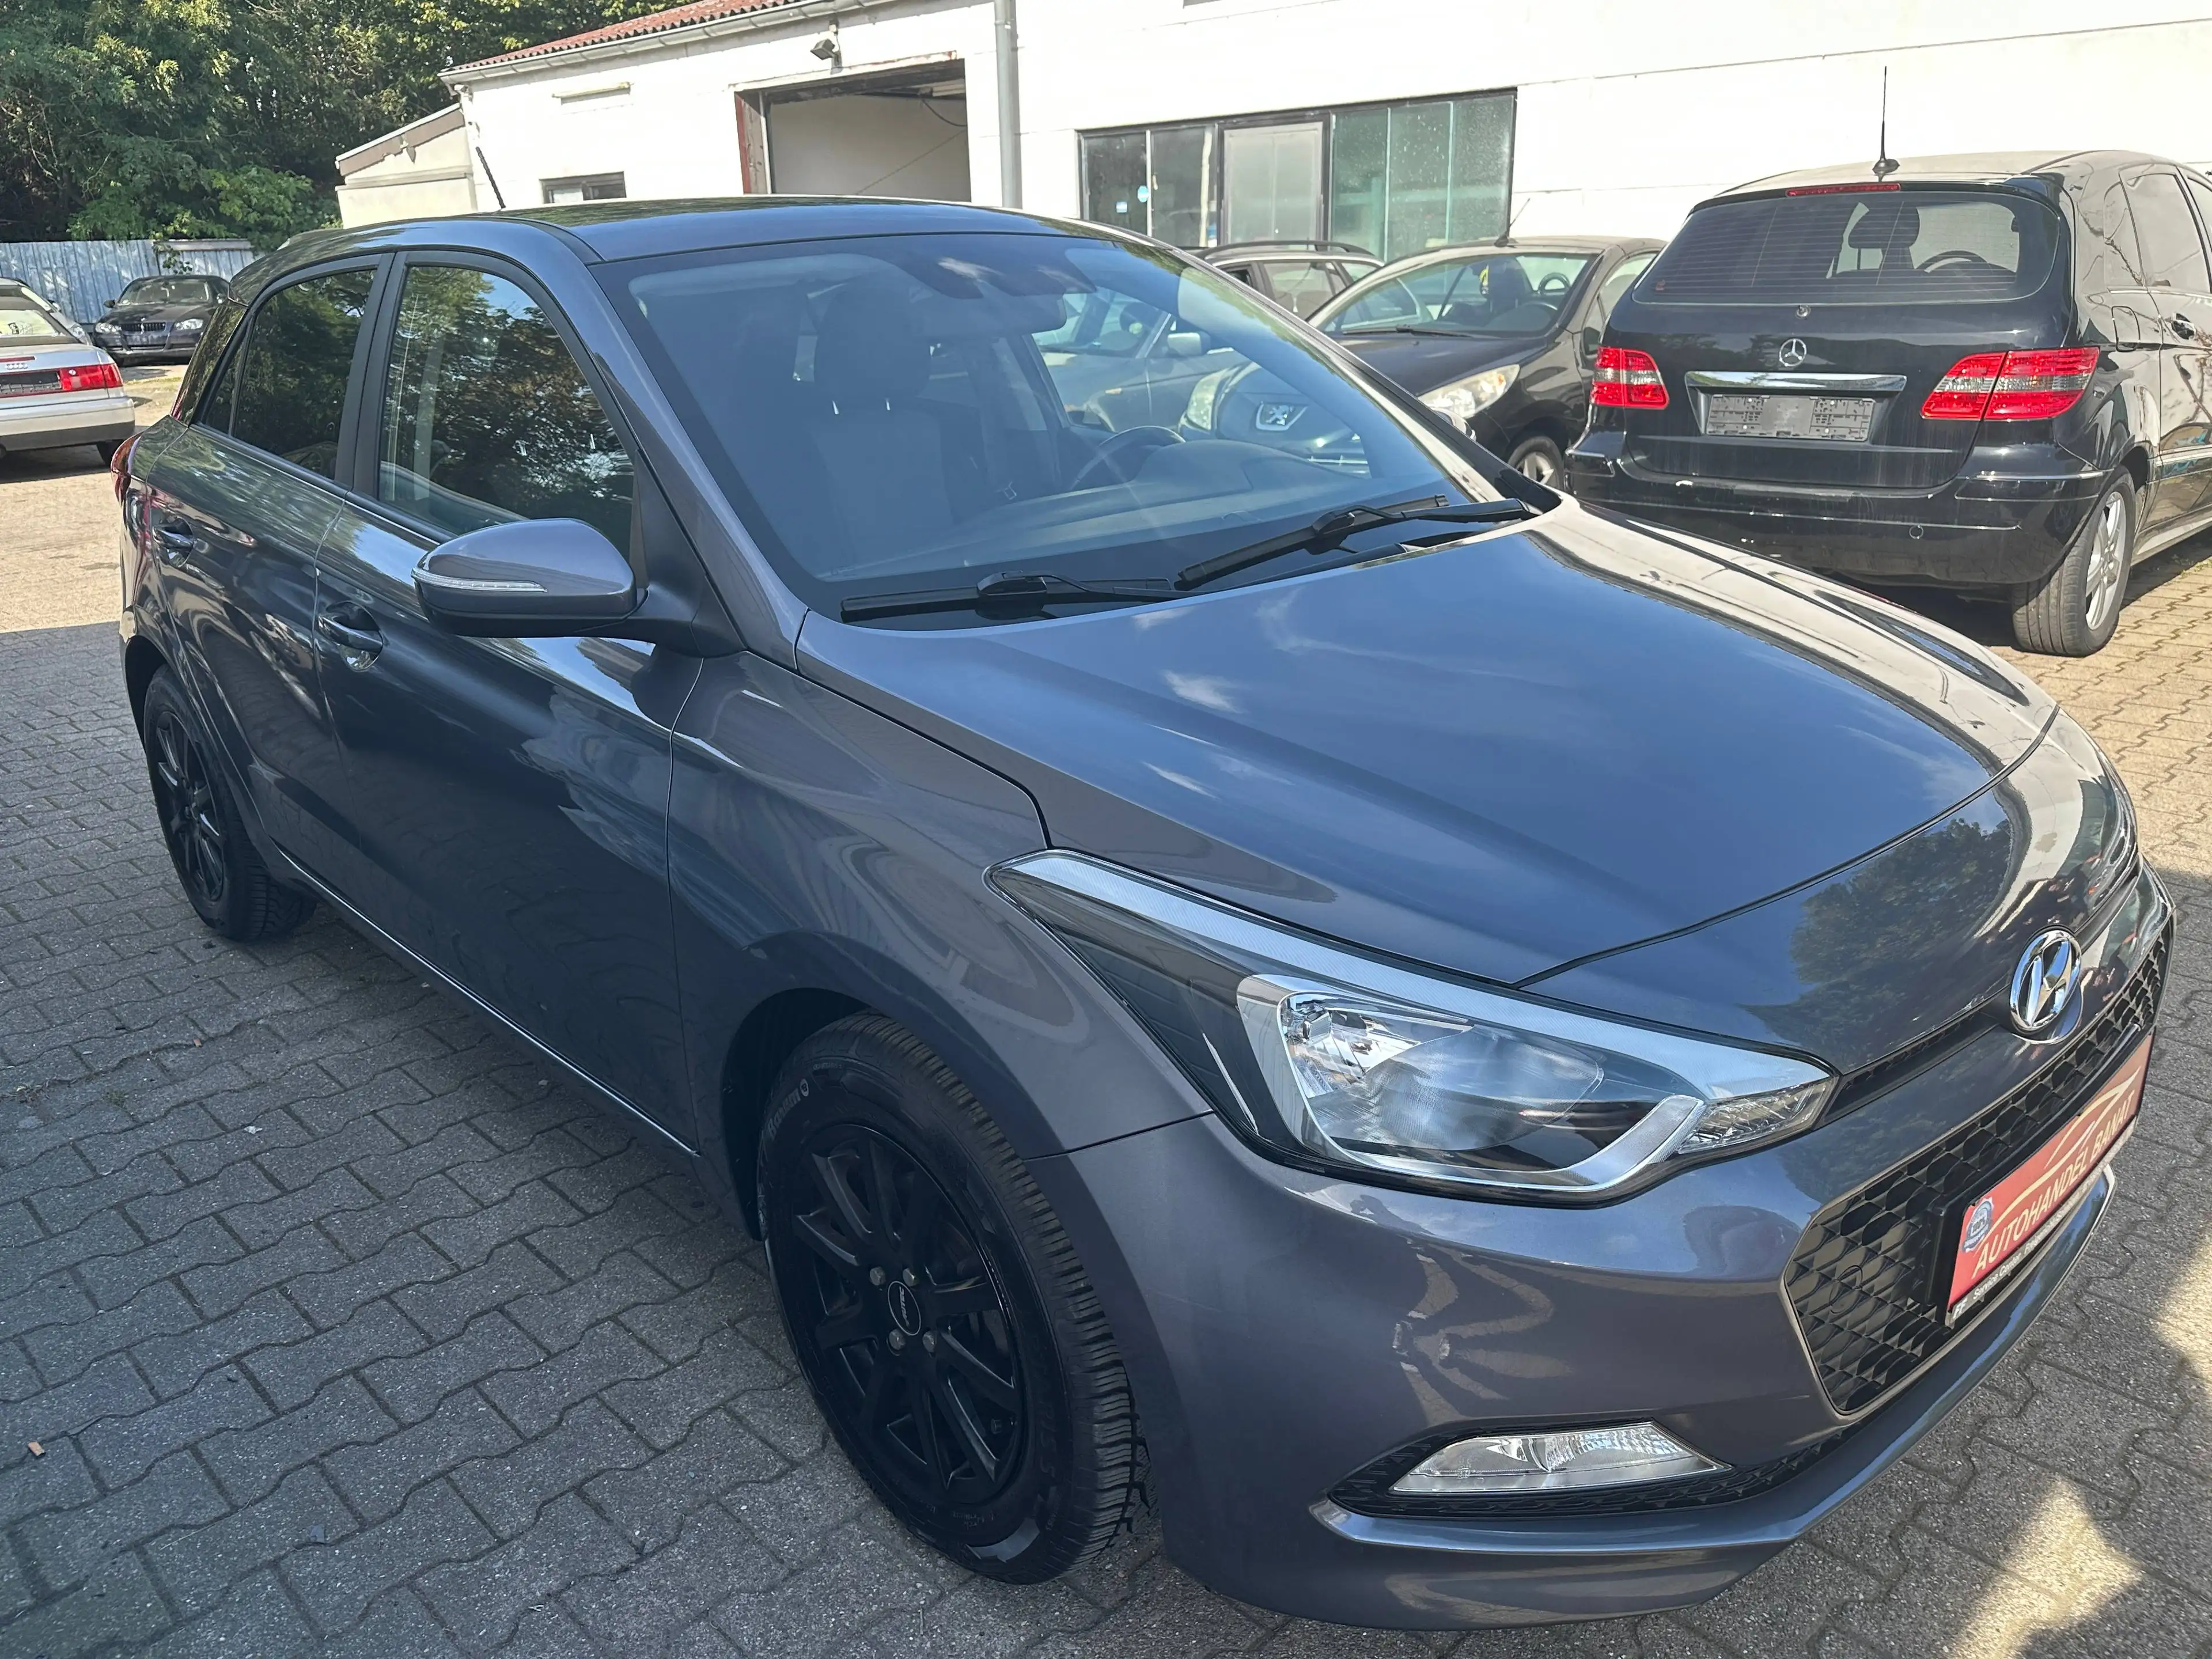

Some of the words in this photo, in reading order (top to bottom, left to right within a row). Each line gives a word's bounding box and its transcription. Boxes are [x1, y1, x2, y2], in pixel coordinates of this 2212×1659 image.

[768, 1087, 801, 1141] Barum
[1971, 1146, 2089, 1279] AUTOHANDEL
[2090, 1089, 2135, 1163] BANAT
